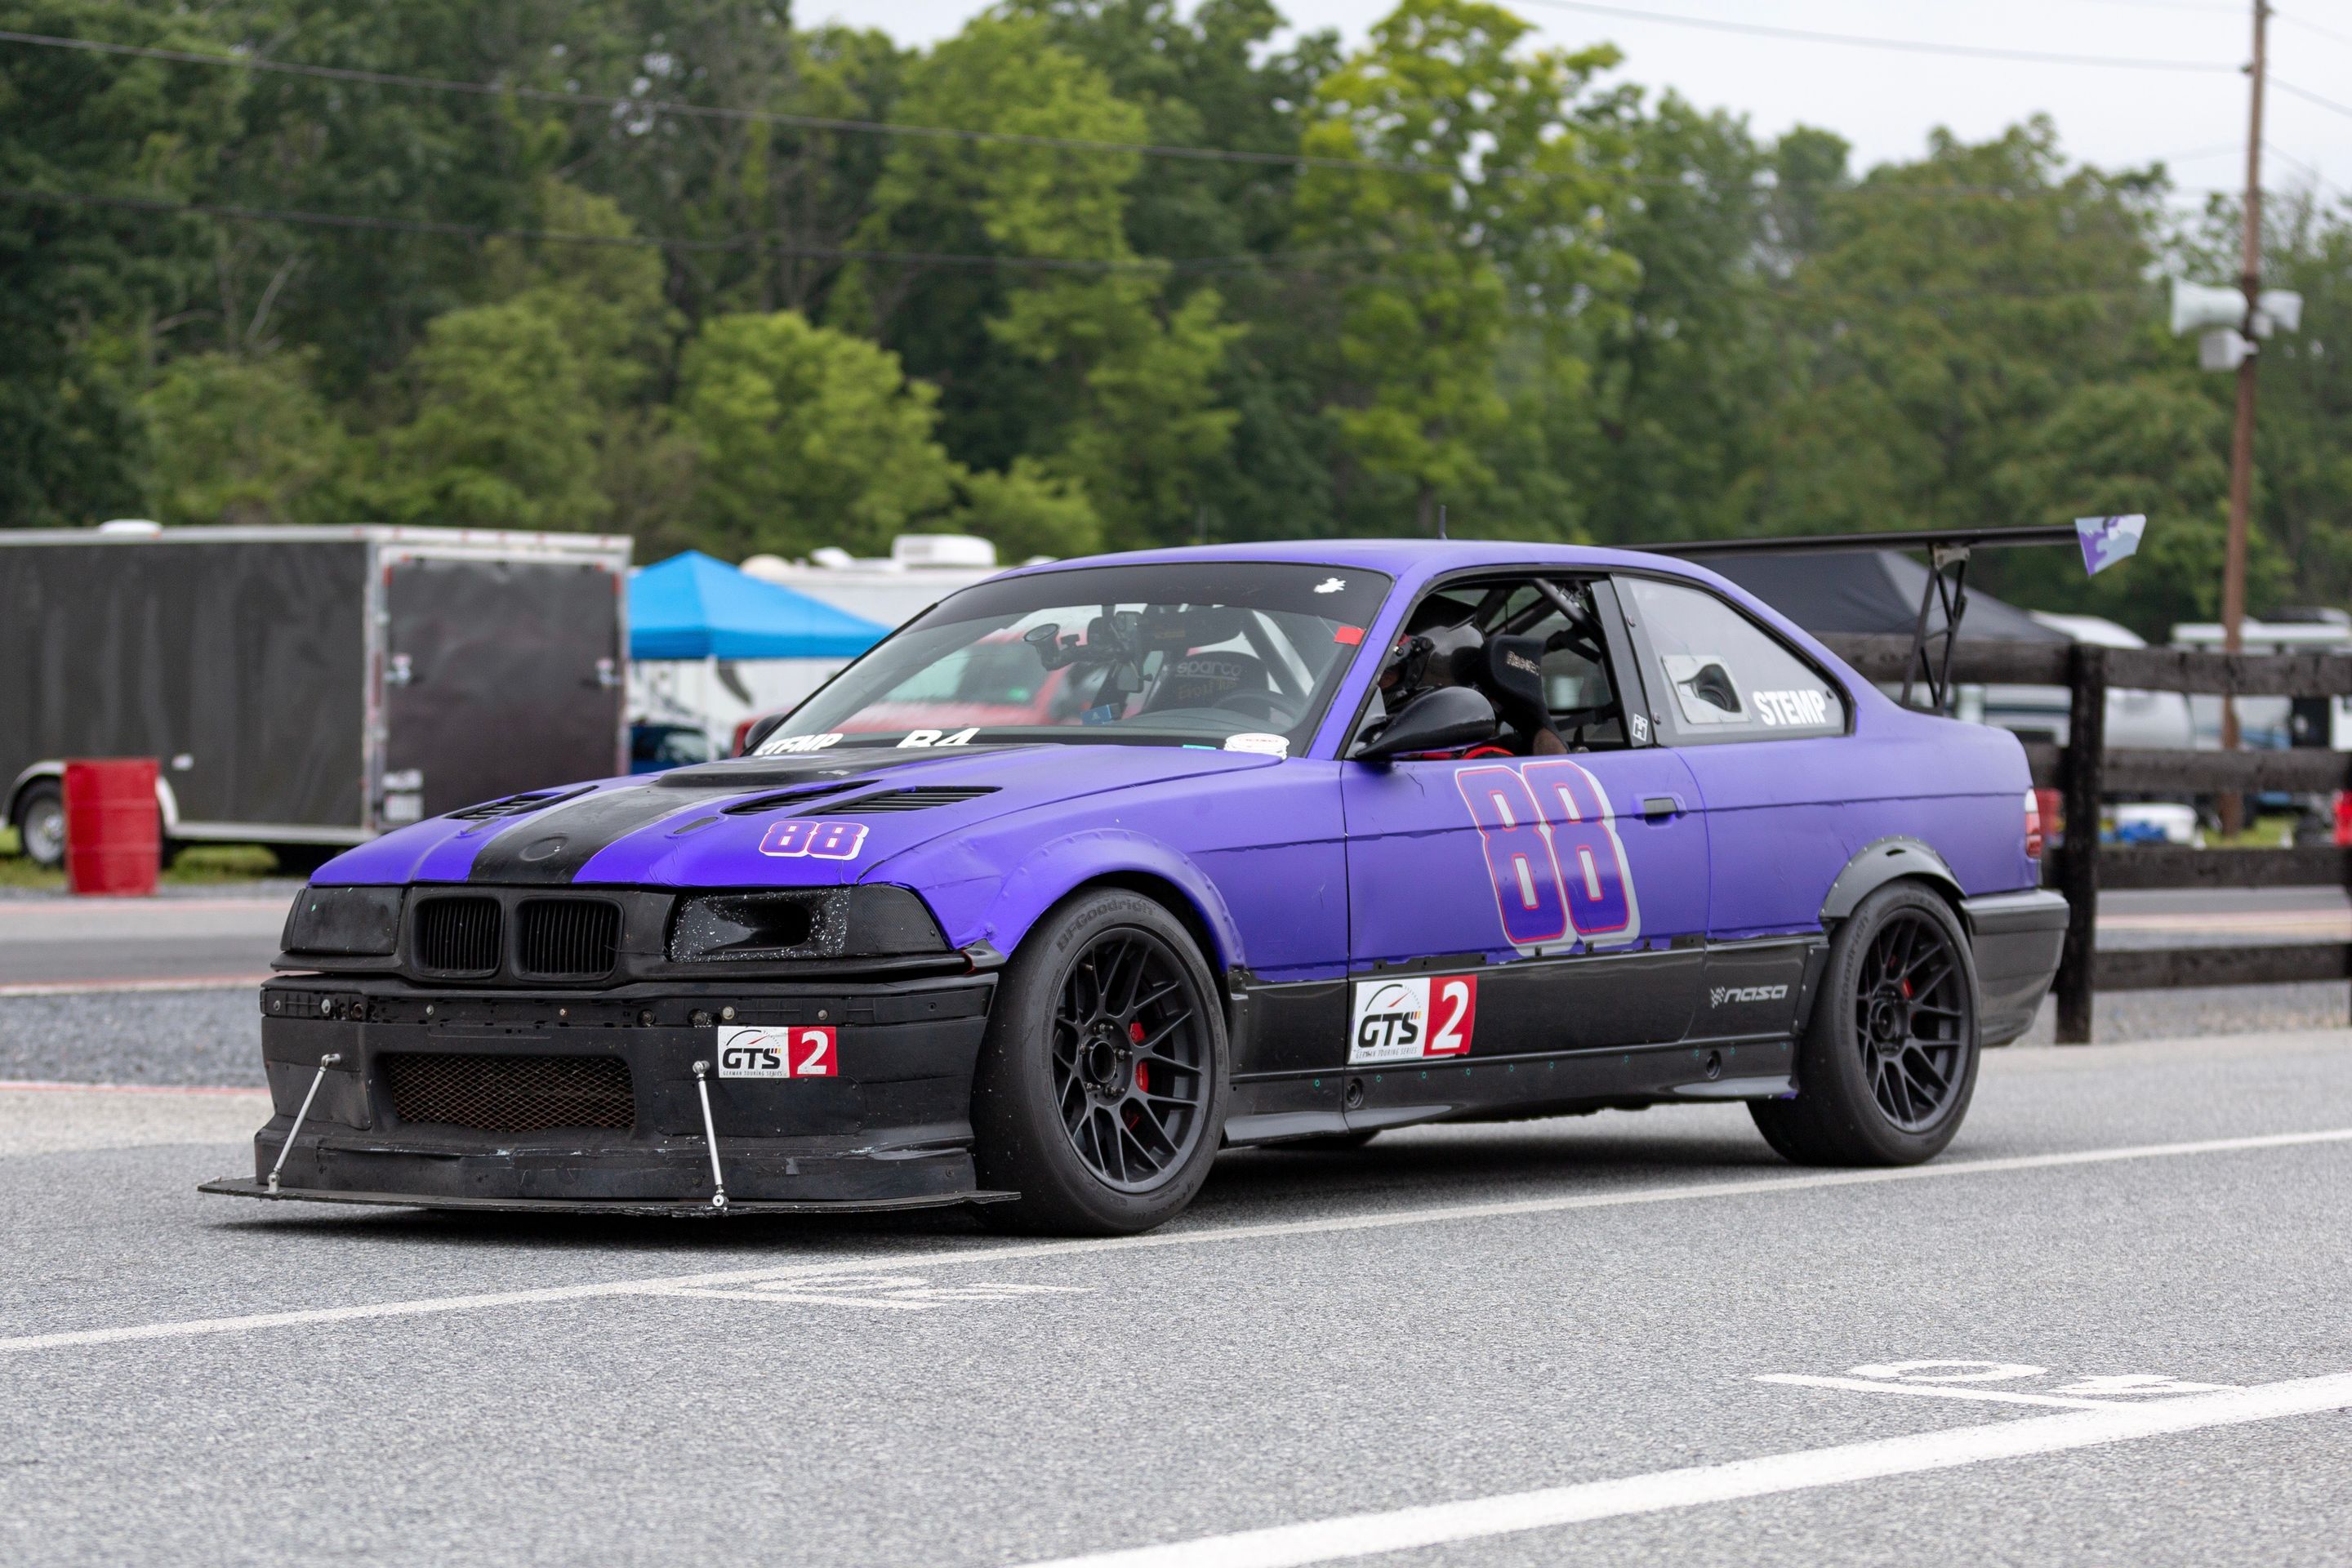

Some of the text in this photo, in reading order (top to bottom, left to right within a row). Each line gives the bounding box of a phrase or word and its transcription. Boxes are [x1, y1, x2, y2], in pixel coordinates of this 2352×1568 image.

[1177, 660, 1242, 678] sparco
[1752, 689, 1826, 726] STEMP
[759, 820, 870, 861] 88
[1454, 760, 1641, 956] 88
[1723, 984, 1788, 1004] nasa
[1357, 980, 1469, 1050] GTS 2
[722, 1030, 829, 1075] GTS 2
[1378, 1048, 1400, 1058] TOURING
[1400, 1046, 1418, 1056] SERIES
